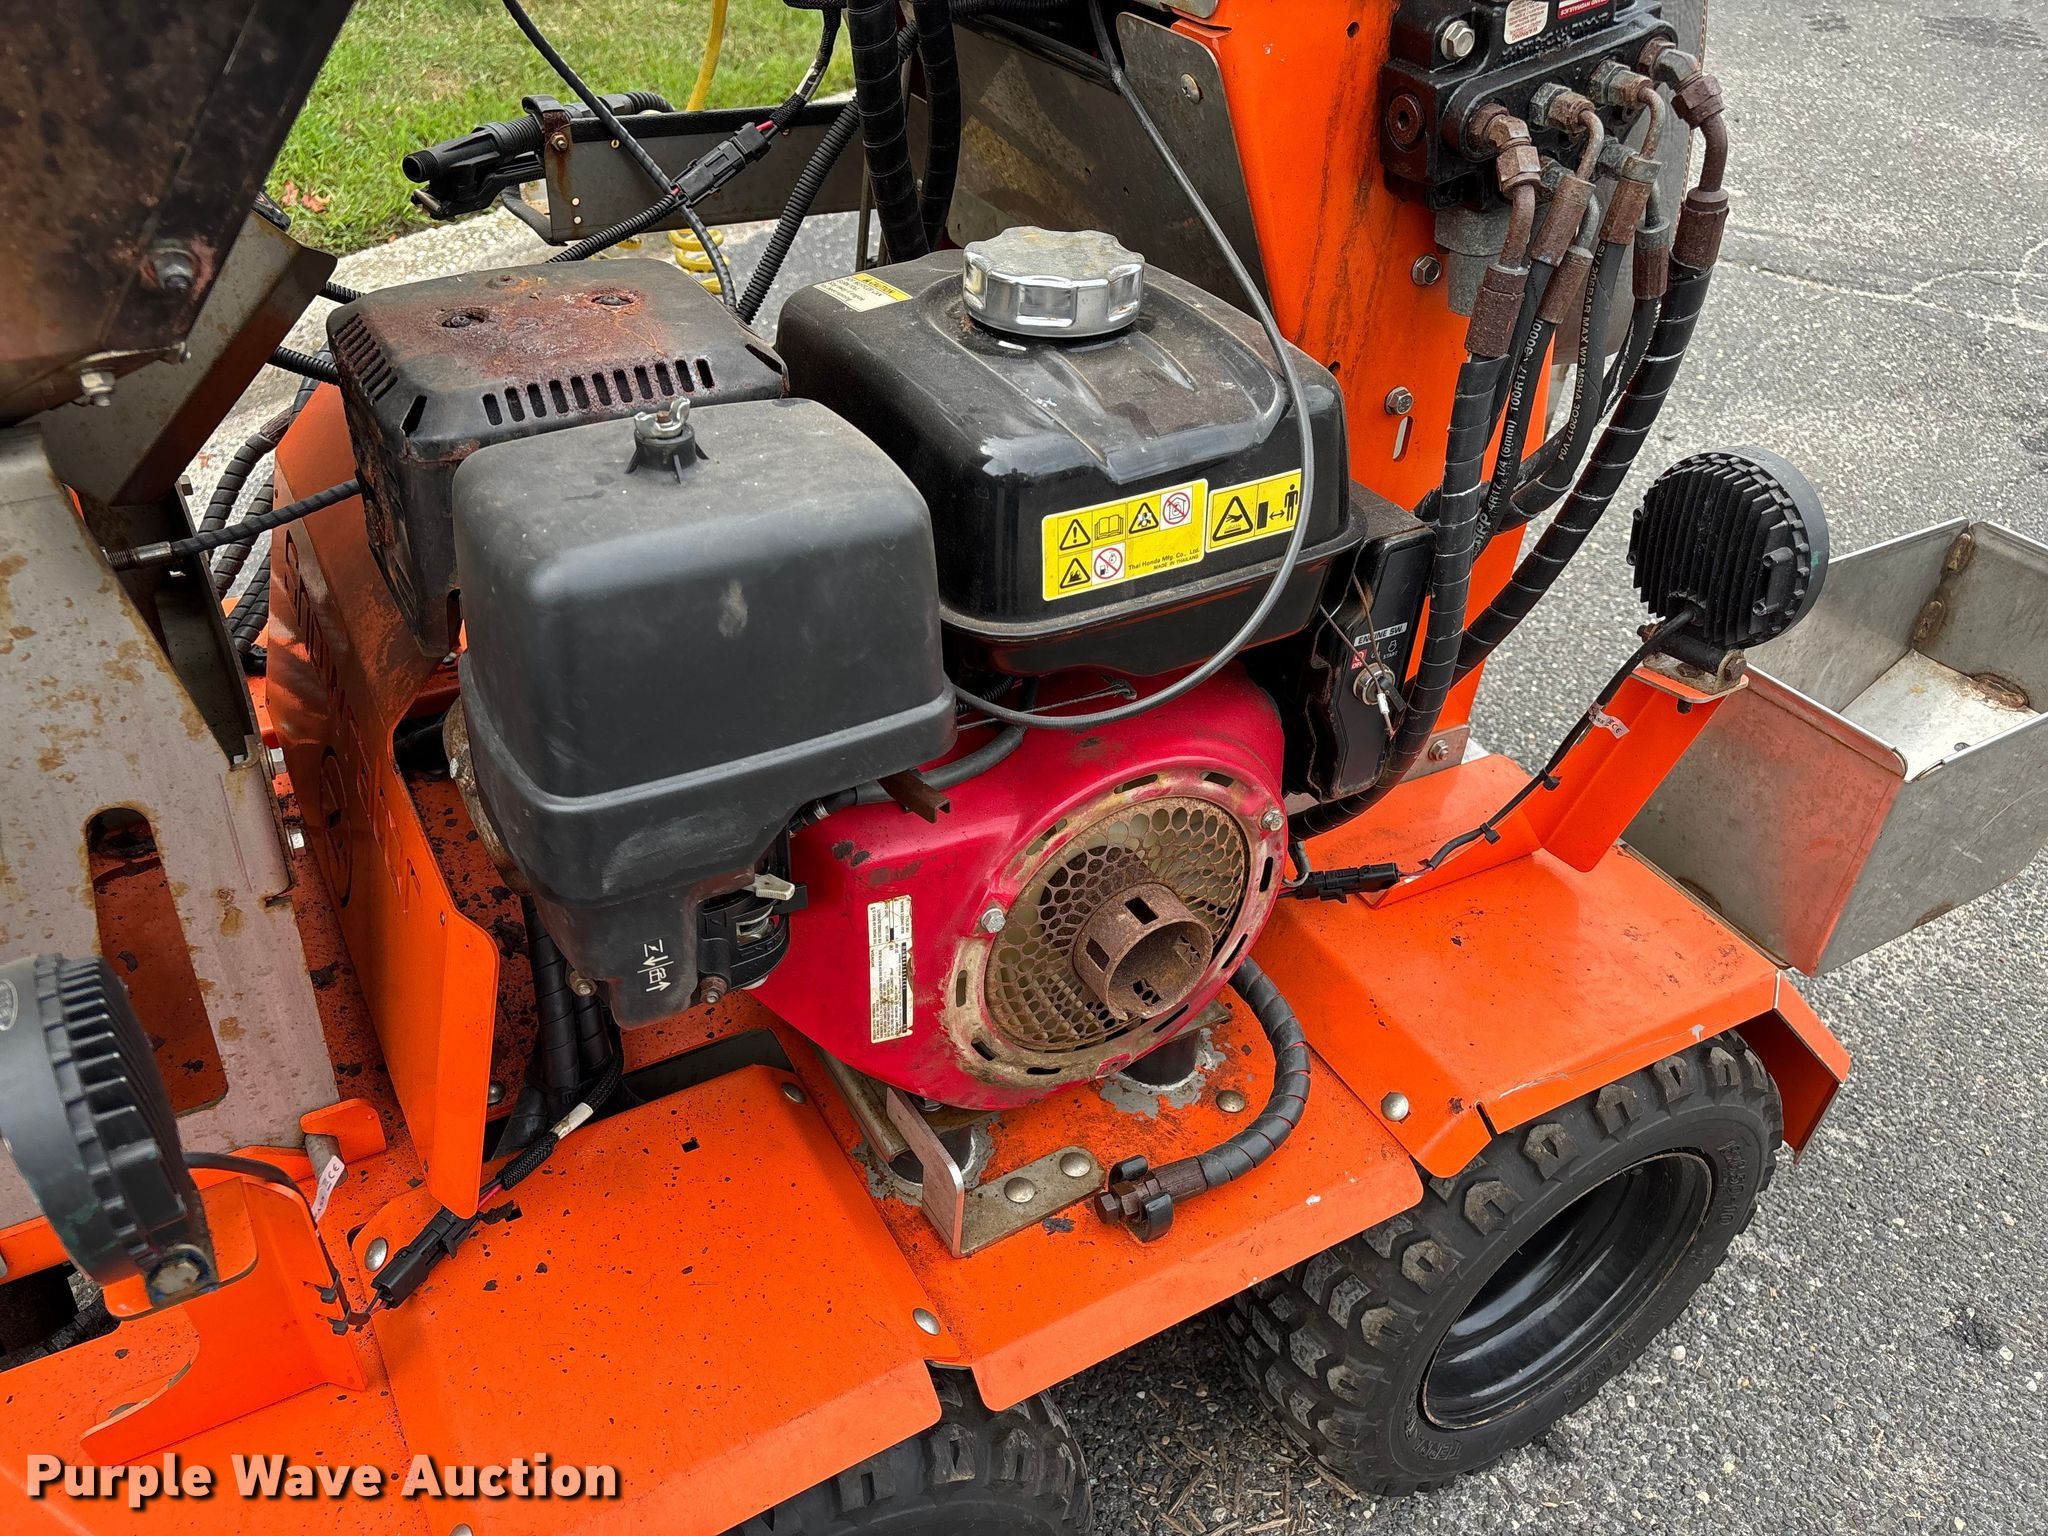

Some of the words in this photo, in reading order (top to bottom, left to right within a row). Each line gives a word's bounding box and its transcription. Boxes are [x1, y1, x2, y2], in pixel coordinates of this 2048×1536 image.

[1583, 264, 1600, 314] 206BAR
[1580, 315, 1591, 343] MAX
[1579, 344, 1589, 366] WP
[1511, 365, 1528, 412] 100R17
[1575, 367, 1586, 400] MSHA
[1501, 419, 1518, 459] (6mm)
[1558, 441, 1572, 462] V04
[1497, 460, 1508, 480] 1/4
[1128, 562, 1142, 571] Thai
[1141, 558, 1162, 569] Honda
[1153, 562, 1168, 571] MADE
[1175, 554, 1200, 565] THAILAND
[1357, 630, 1388, 644] ENINE
[1383, 650, 1399, 660] START
